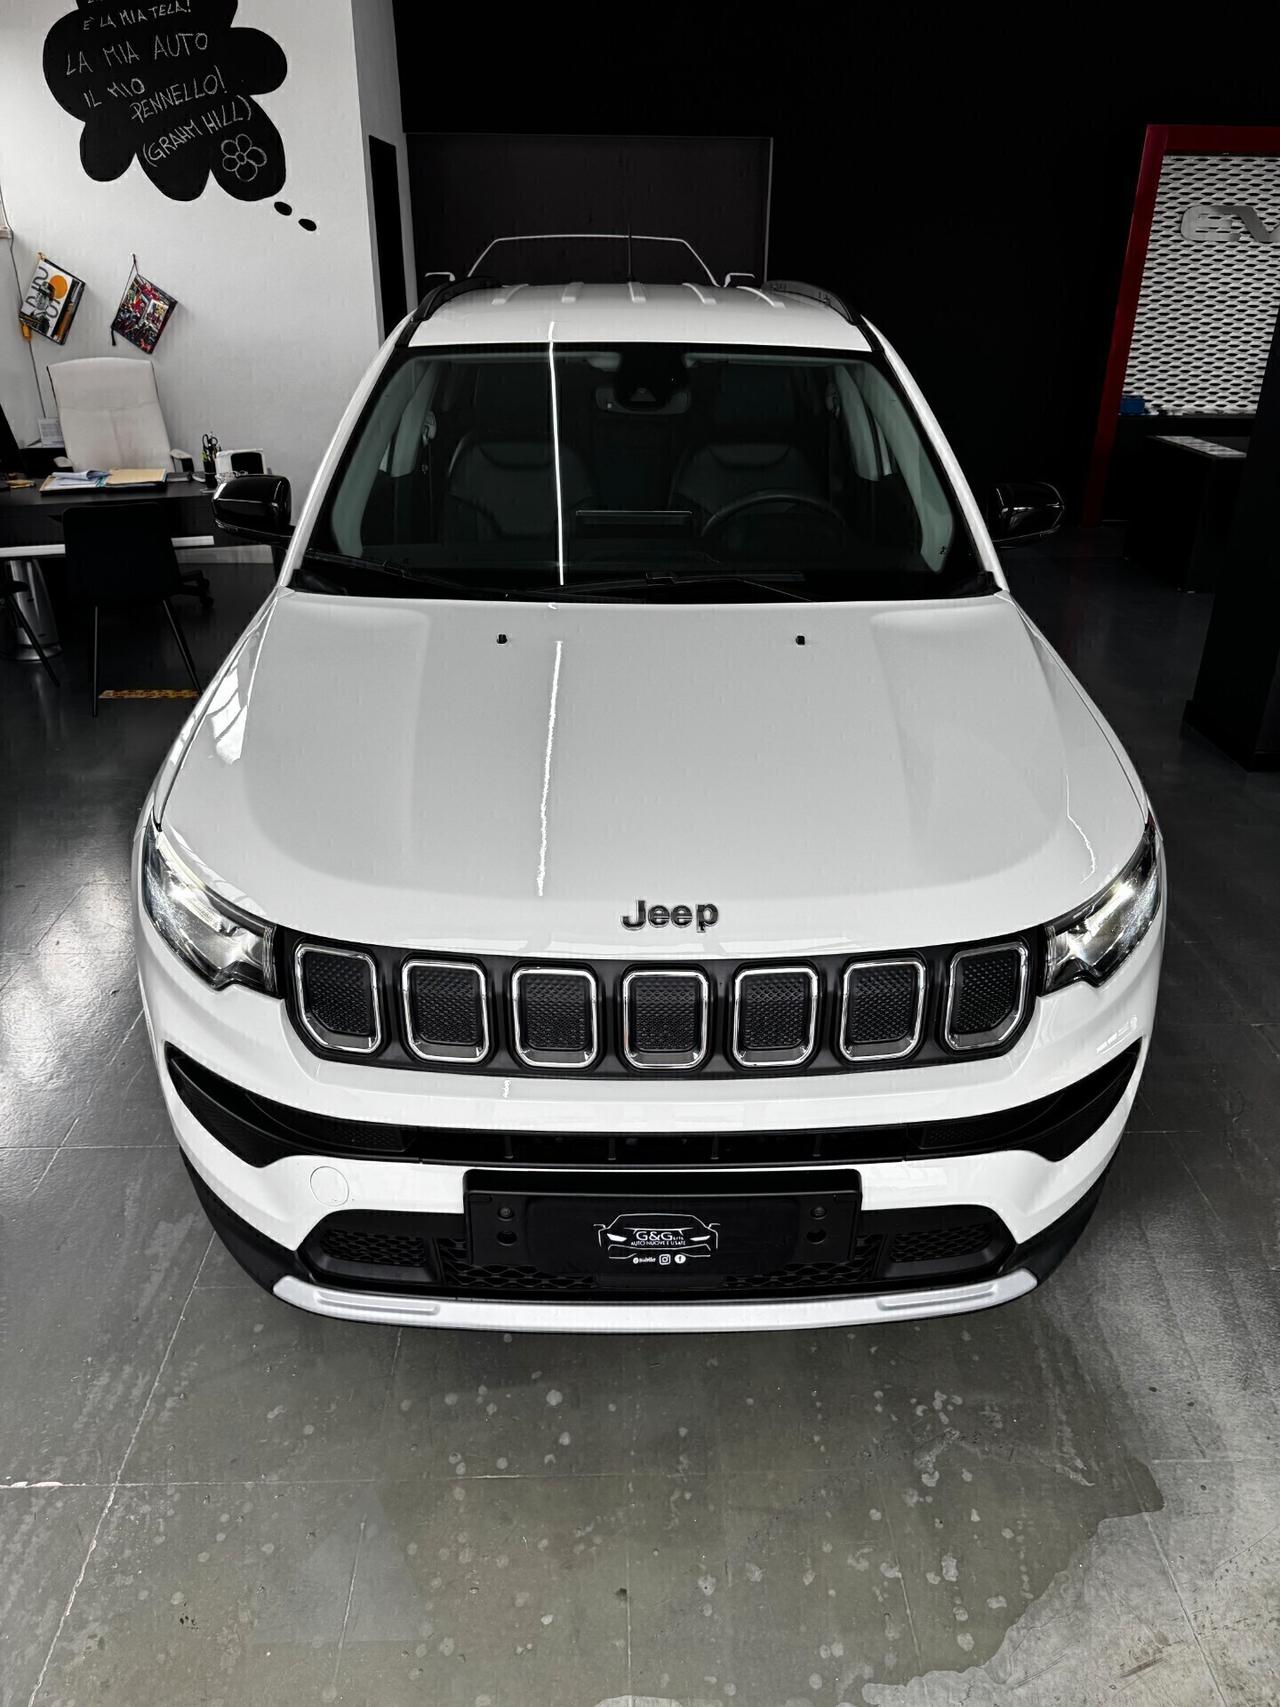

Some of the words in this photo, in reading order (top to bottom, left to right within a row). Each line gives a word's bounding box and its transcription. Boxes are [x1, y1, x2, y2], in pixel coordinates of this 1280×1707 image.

[100, 14, 117, 28] LA
[120, 9, 148, 26] MIA
[148, 0, 192, 18] TELA!
[66, 51, 94, 76] LA
[103, 41, 140, 66] MIA
[154, 32, 208, 60] AUTO
[84, 90, 102, 108] IL
[107, 77, 145, 98] MIO
[130, 65, 228, 123] PENNELLO!
[201, 94, 252, 134] HILL)
[621, 899, 719, 933] Jeep
[636, 1230, 673, 1241] G&G
